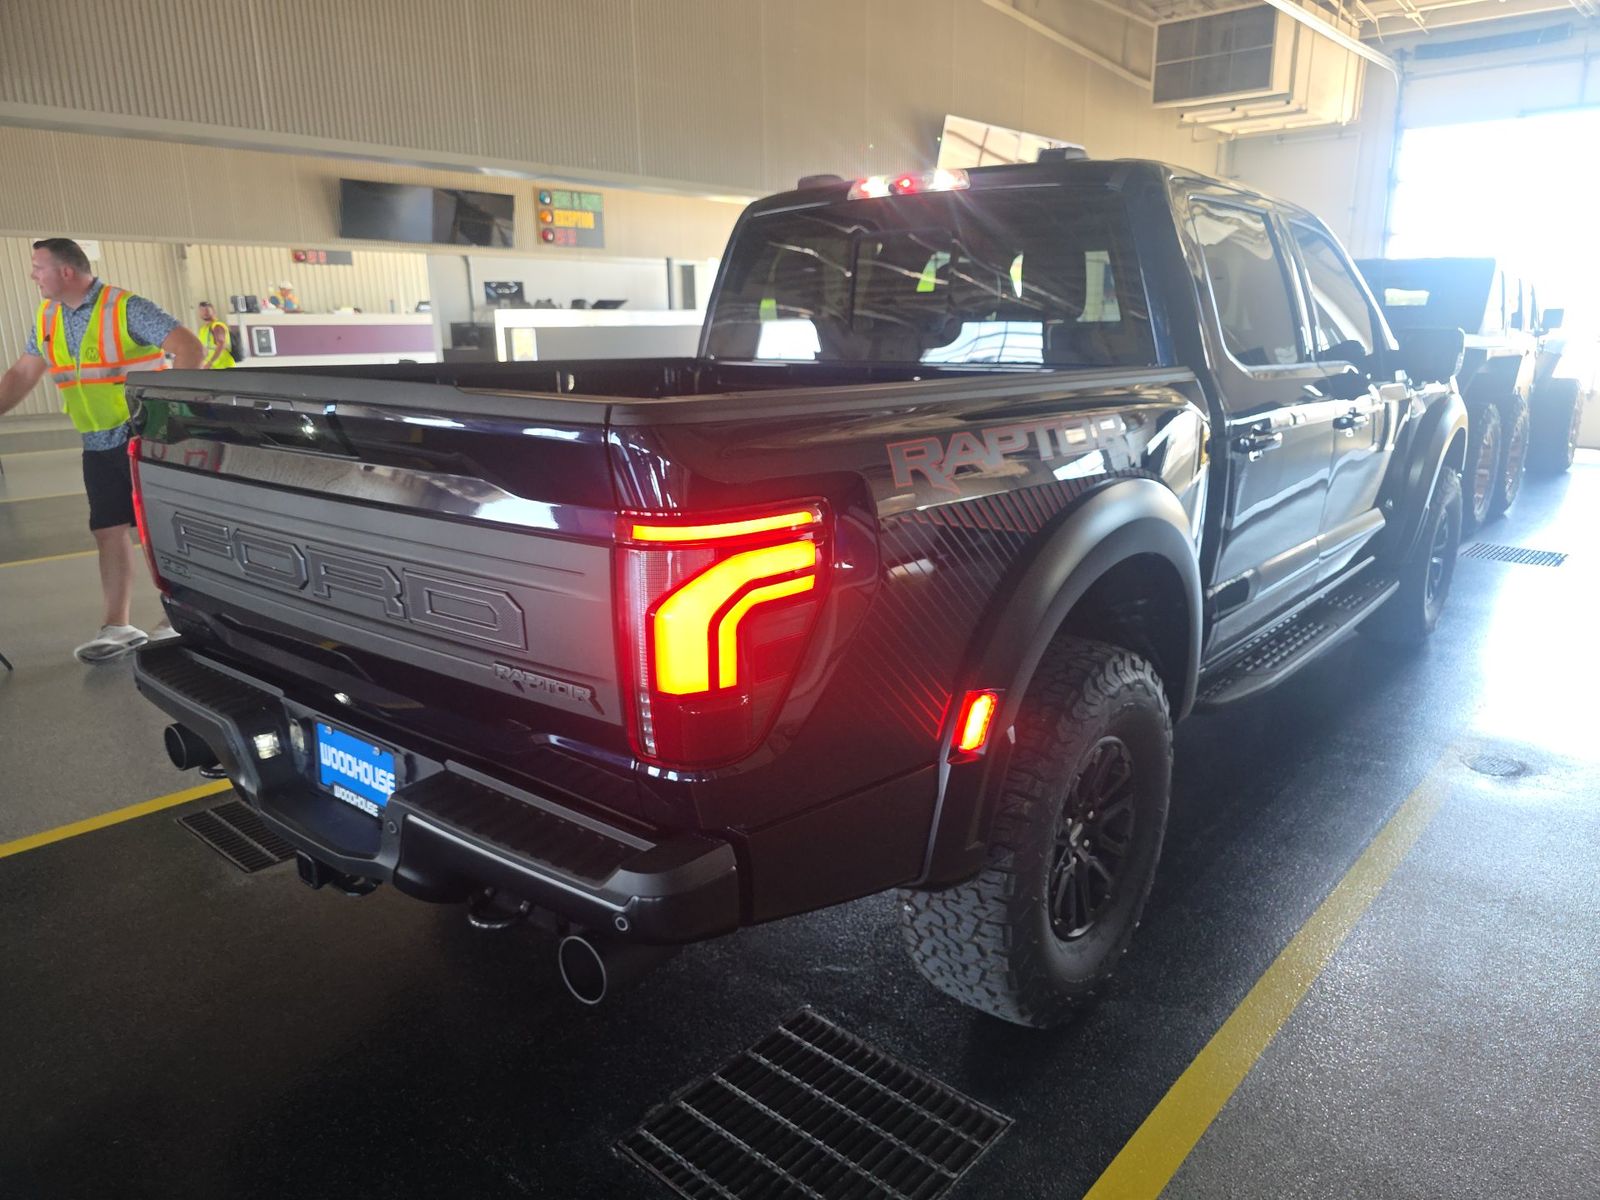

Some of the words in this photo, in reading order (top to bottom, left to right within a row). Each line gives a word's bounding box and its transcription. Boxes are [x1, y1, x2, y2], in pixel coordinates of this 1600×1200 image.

[886, 413, 1142, 494] RAPTOR
[171, 511, 528, 651] FORD
[493, 661, 603, 715] RAPTOR
[320, 741, 396, 796] WOODHOUSE
[333, 784, 379, 818] WOODHOUSE
